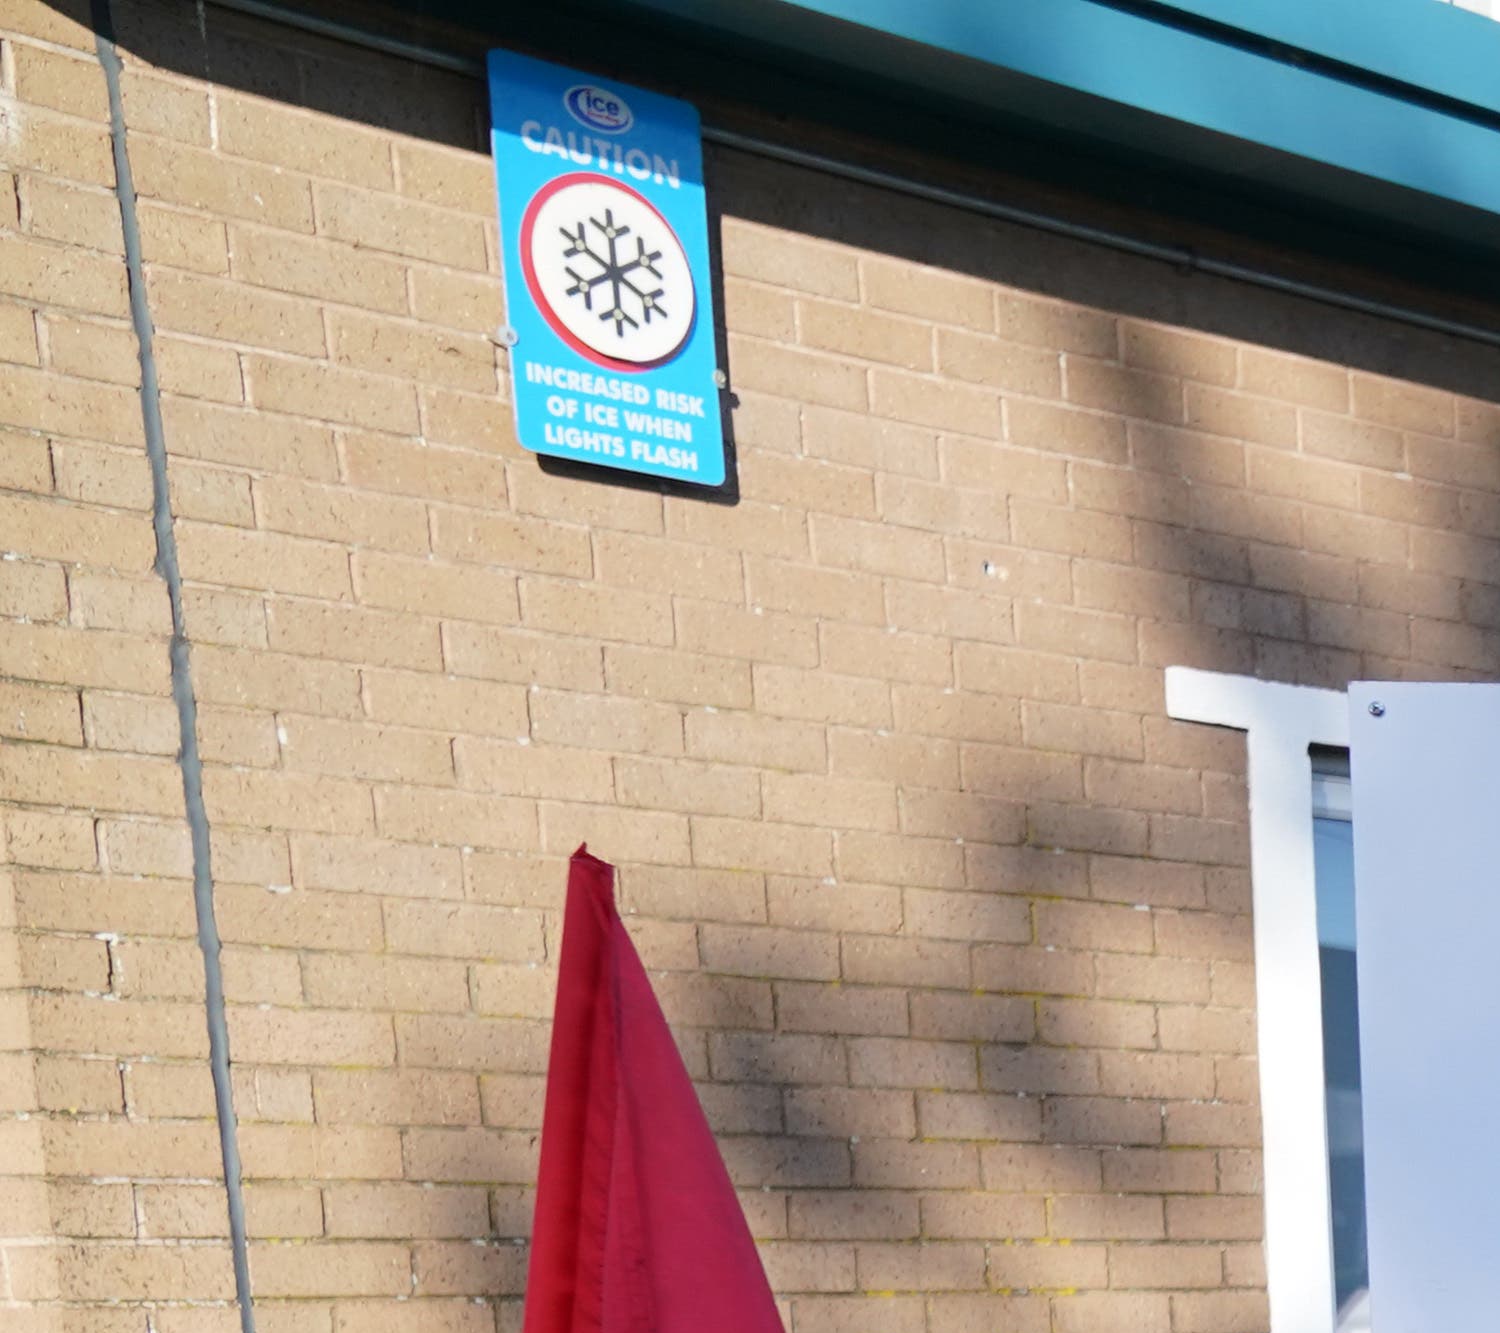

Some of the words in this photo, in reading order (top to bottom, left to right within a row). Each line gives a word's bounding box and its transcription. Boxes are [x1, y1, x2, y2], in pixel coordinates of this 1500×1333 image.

[521, 120, 680, 189] CAUTION
[525, 361, 649, 405] INCREASED
[655, 388, 705, 418] RISK
[546, 395, 578, 419] OF
[584, 403, 619, 428] ICE
[623, 410, 692, 443] WHEN
[544, 423, 625, 458] LIGHTS
[631, 441, 698, 472] FLASH
